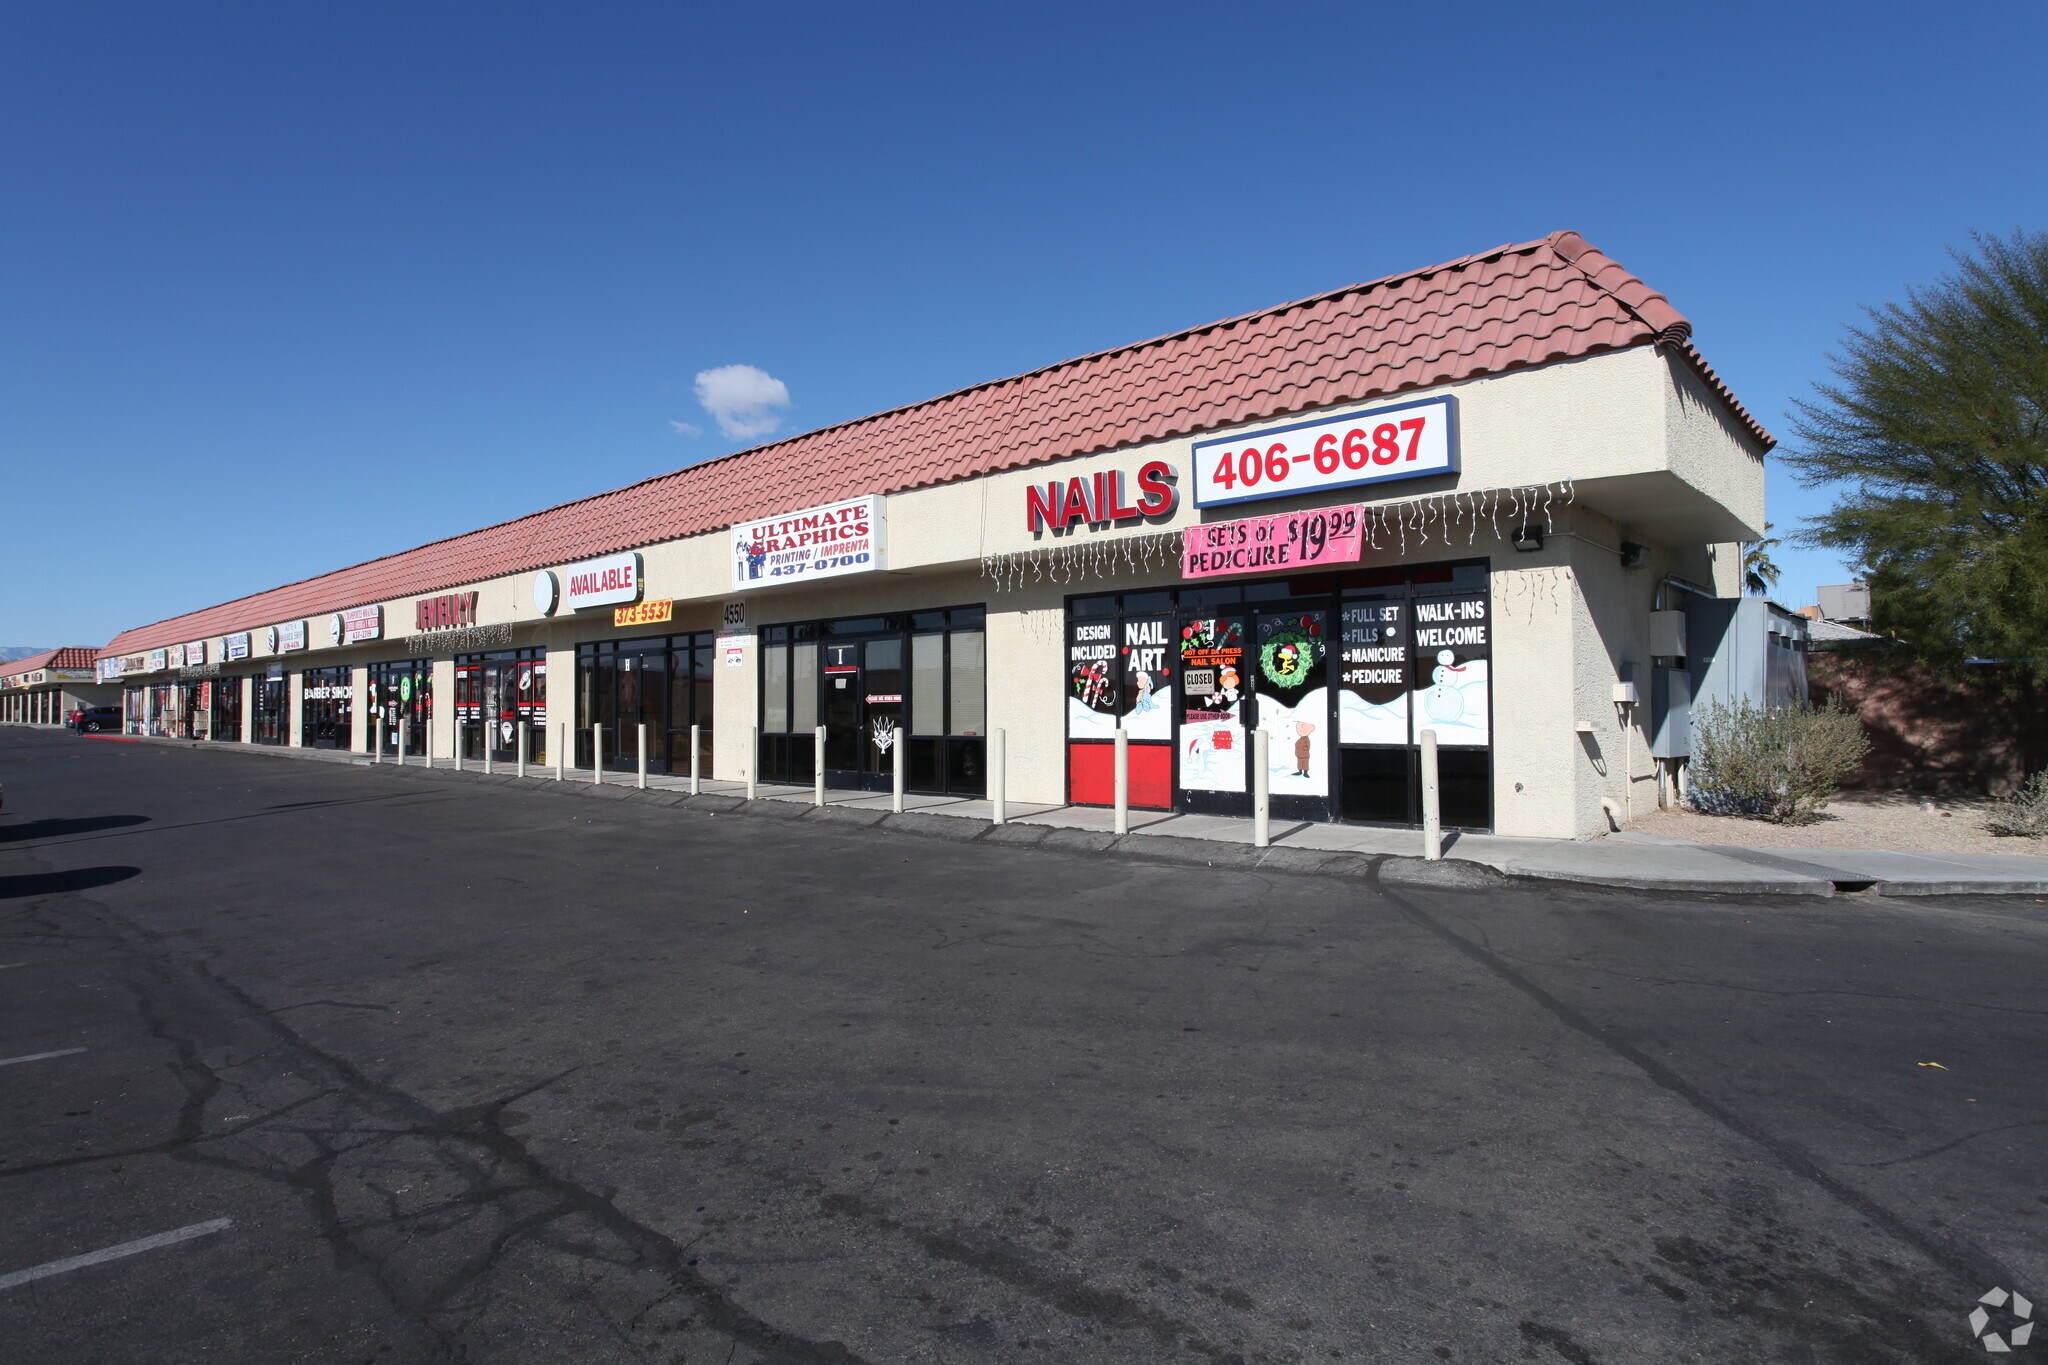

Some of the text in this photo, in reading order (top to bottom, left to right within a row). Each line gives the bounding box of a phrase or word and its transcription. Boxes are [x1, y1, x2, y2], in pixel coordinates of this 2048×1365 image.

[1212, 416, 1427, 490] 406-6687
[1026, 461, 1176, 532] NAILS
[751, 504, 868, 540] ULTIMATE
[750, 521, 869, 556] GRAPHICS
[1207, 524, 1247, 547] SETS
[770, 549, 811, 566] PRINTING
[820, 538, 869, 558] IMPRENTA
[1189, 543, 1290, 574] PEDICURE
[769, 552, 870, 577] 437-0700
[569, 565, 633, 597] AVAILABLE
[416, 591, 477, 630] JEWELRY
[616, 600, 672, 624] 373-5537
[724, 602, 745, 624] 4550
[1379, 606, 1400, 622] SET
[1416, 600, 1486, 622] WALK-INS
[1076, 625, 1111, 641] DESIGN
[1125, 621, 1168, 646] NAIL
[1206, 620, 1216, 641] J
[1416, 626, 1487, 647] WELCOME
[1071, 644, 1117, 661] INCLUDED
[1128, 648, 1165, 672] ART
[1191, 657, 1236, 666] NAIL SALON
[1186, 673, 1213, 686] CLOSED
[304, 685, 352, 700] BARBER SHOP
